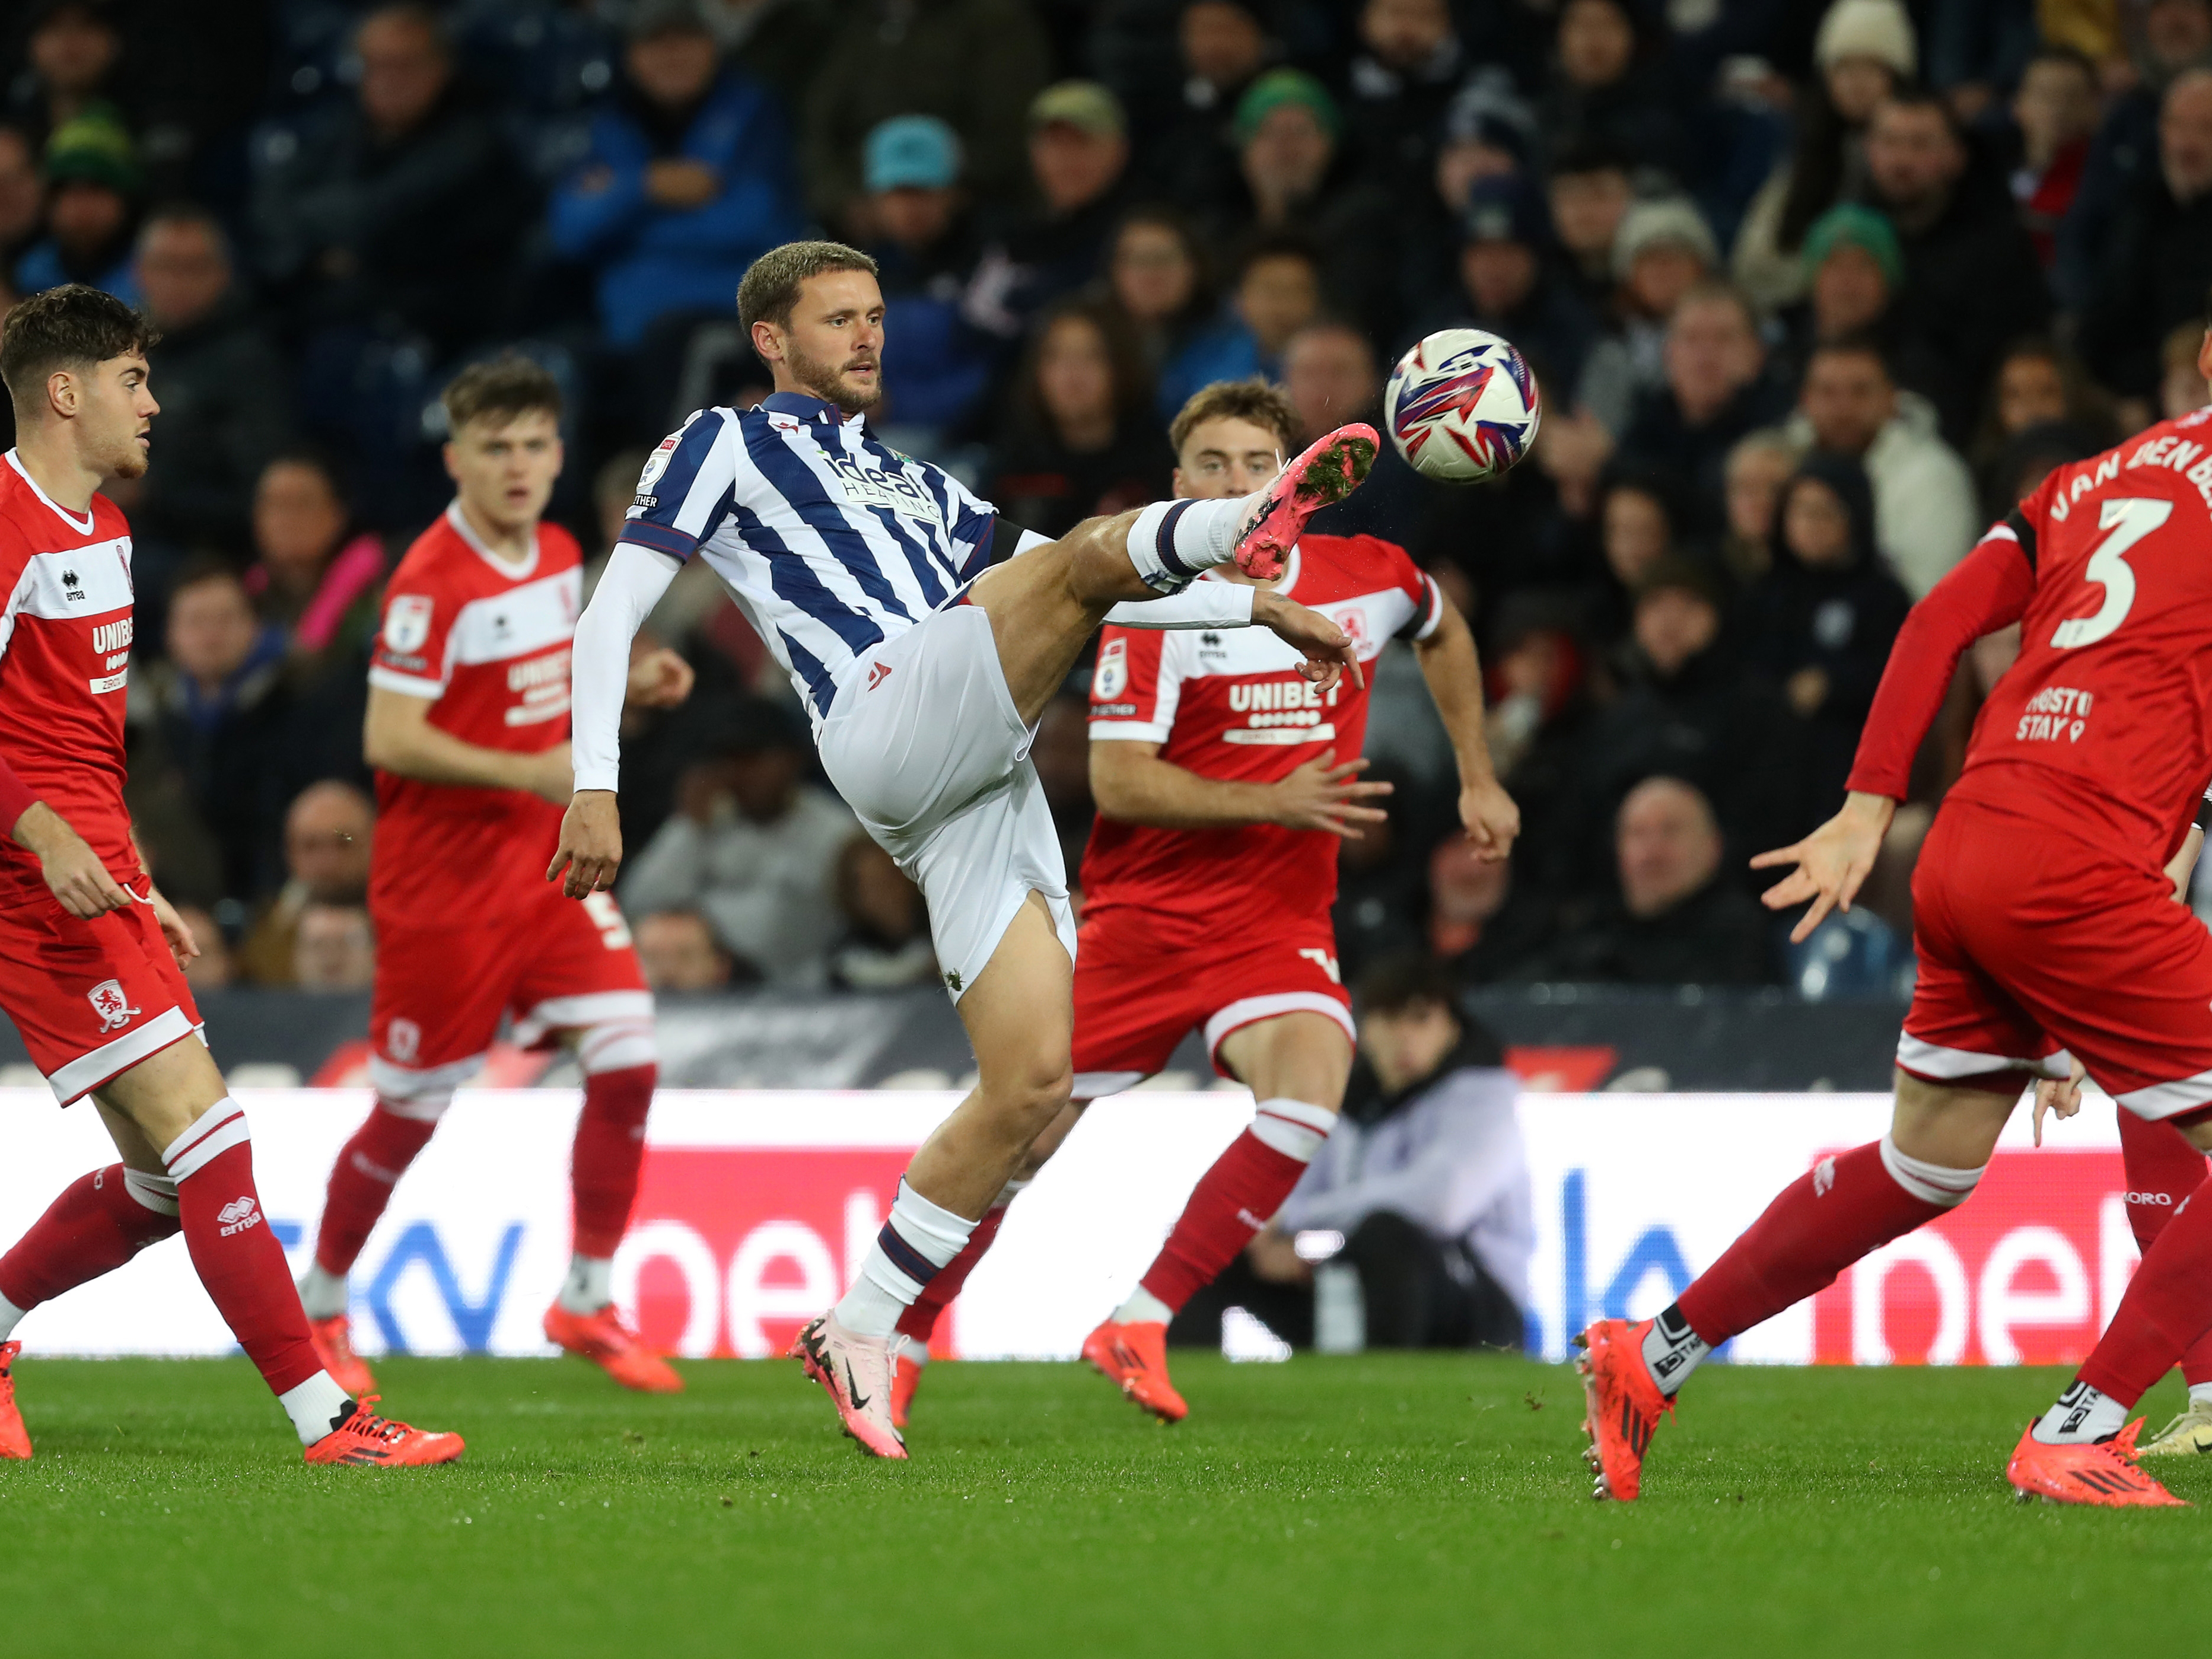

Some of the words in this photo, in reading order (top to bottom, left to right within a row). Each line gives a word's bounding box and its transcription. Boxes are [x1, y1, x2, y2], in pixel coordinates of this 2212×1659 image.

[816, 449, 931, 503] ideal
[2050, 451, 2121, 522] VAN
[842, 482, 940, 519] HEATING
[2050, 497, 2175, 649] 3
[1229, 678, 1343, 712] UNIBET
[2016, 714, 2070, 741] STAY
